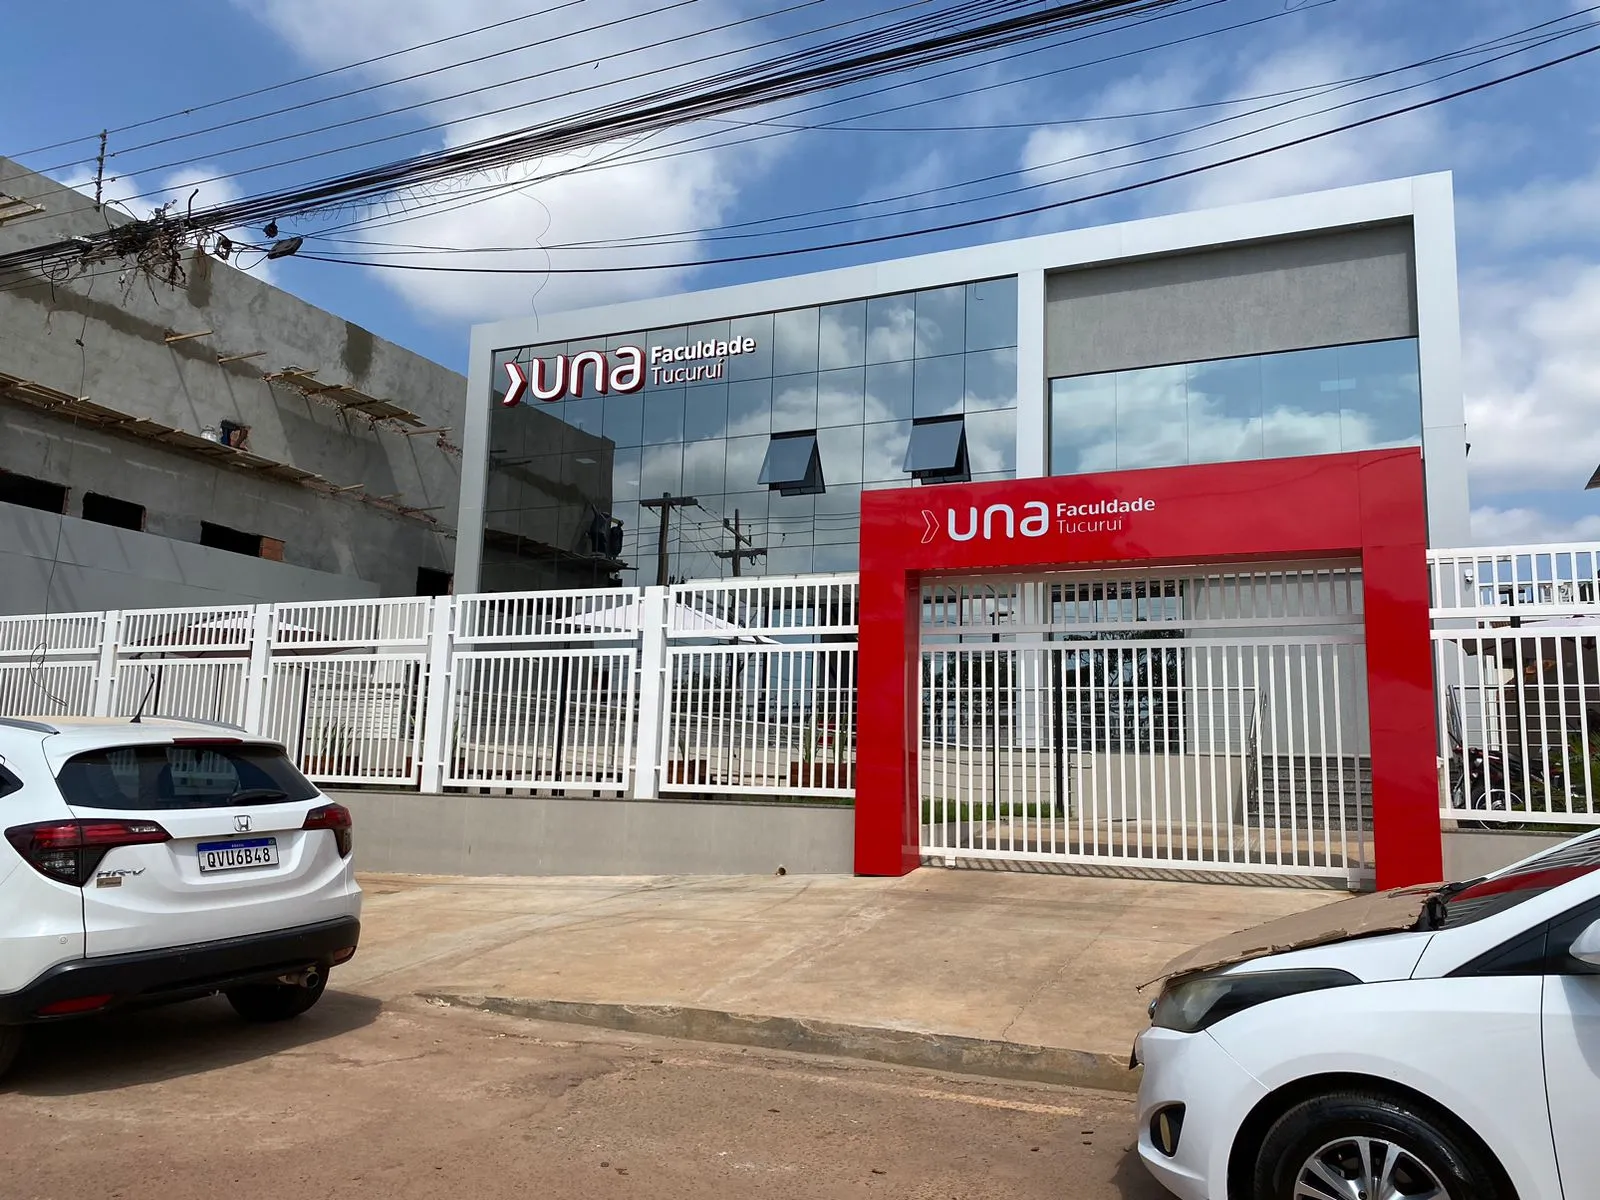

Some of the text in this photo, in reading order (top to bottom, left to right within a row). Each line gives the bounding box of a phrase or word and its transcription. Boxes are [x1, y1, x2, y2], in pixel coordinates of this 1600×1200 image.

[651, 336, 756, 364] Faculdade
[531, 345, 646, 402] una
[651, 359, 724, 385] Tucuruí
[1056, 497, 1156, 517] Faculdade
[947, 501, 1049, 541] una
[207, 847, 271, 868] QVU6B48
